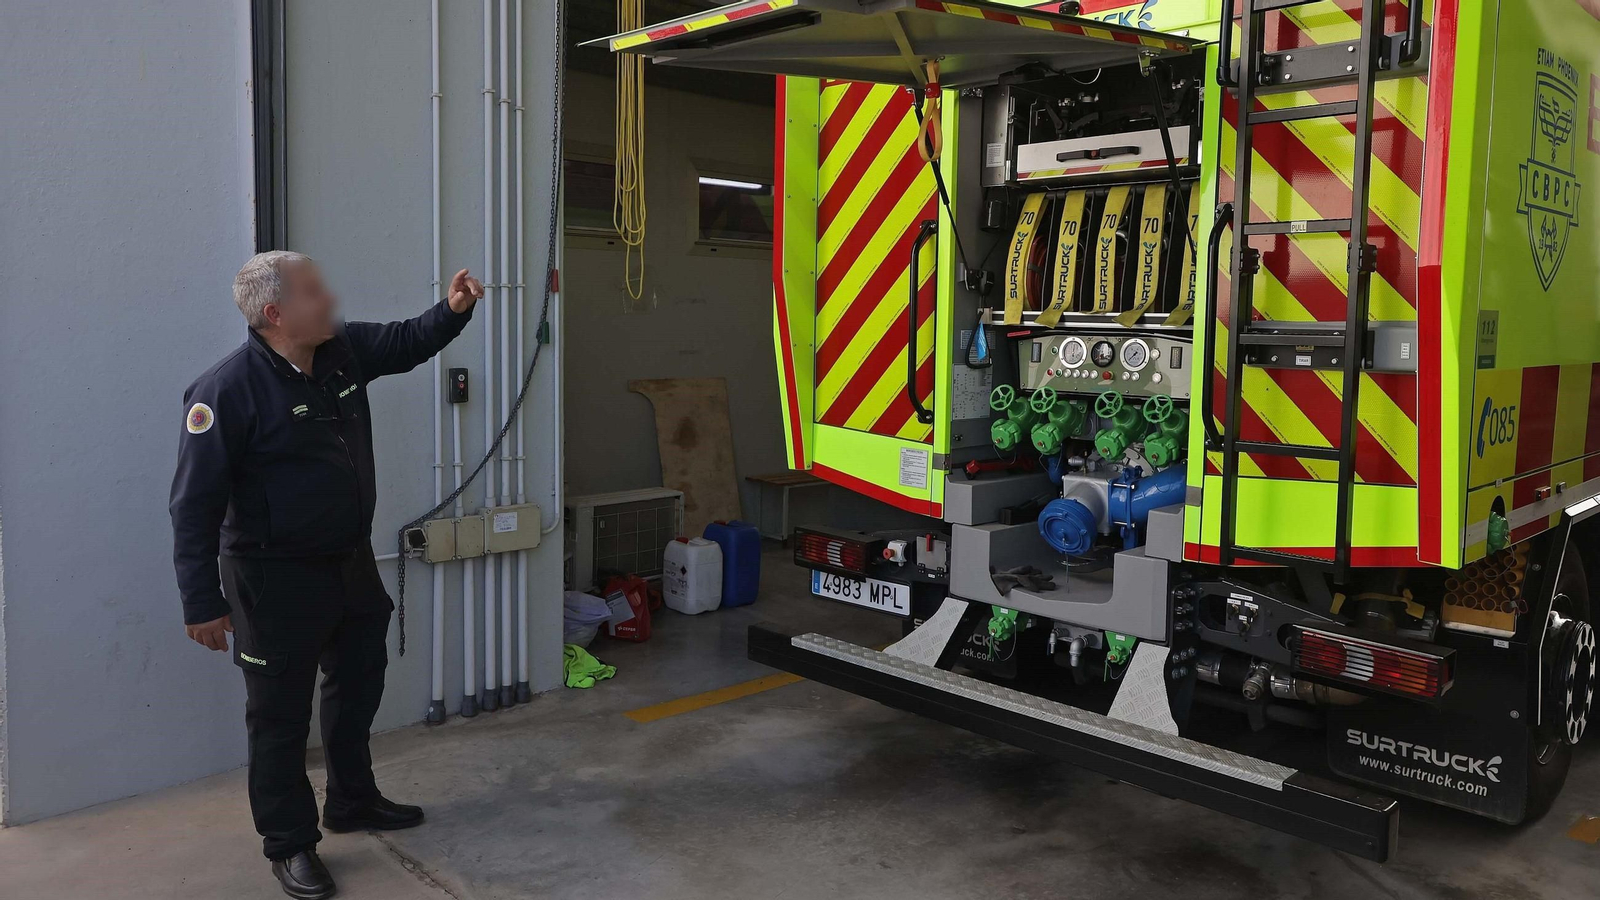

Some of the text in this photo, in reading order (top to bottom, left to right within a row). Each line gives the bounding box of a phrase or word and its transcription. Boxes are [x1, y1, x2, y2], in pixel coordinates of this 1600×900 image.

[1020, 211, 1035, 225] 70
[1062, 220, 1077, 236] 70
[1103, 213, 1117, 229] 70
[1144, 217, 1159, 234] 70
[1191, 215, 1199, 231] 7
[1291, 224, 1306, 232] PULL
[1010, 237, 1025, 299] SURTRUCK
[1053, 248, 1071, 310] SURTRUCK
[1099, 243, 1110, 310] SURTRUCK
[1481, 320, 1496, 335] 112
[1489, 405, 1516, 446] 085
[823, 572, 903, 610] 4983 MPL
[1346, 728, 1486, 777] SURTRUCK
[1359, 755, 1488, 797] www.surtruck.com
